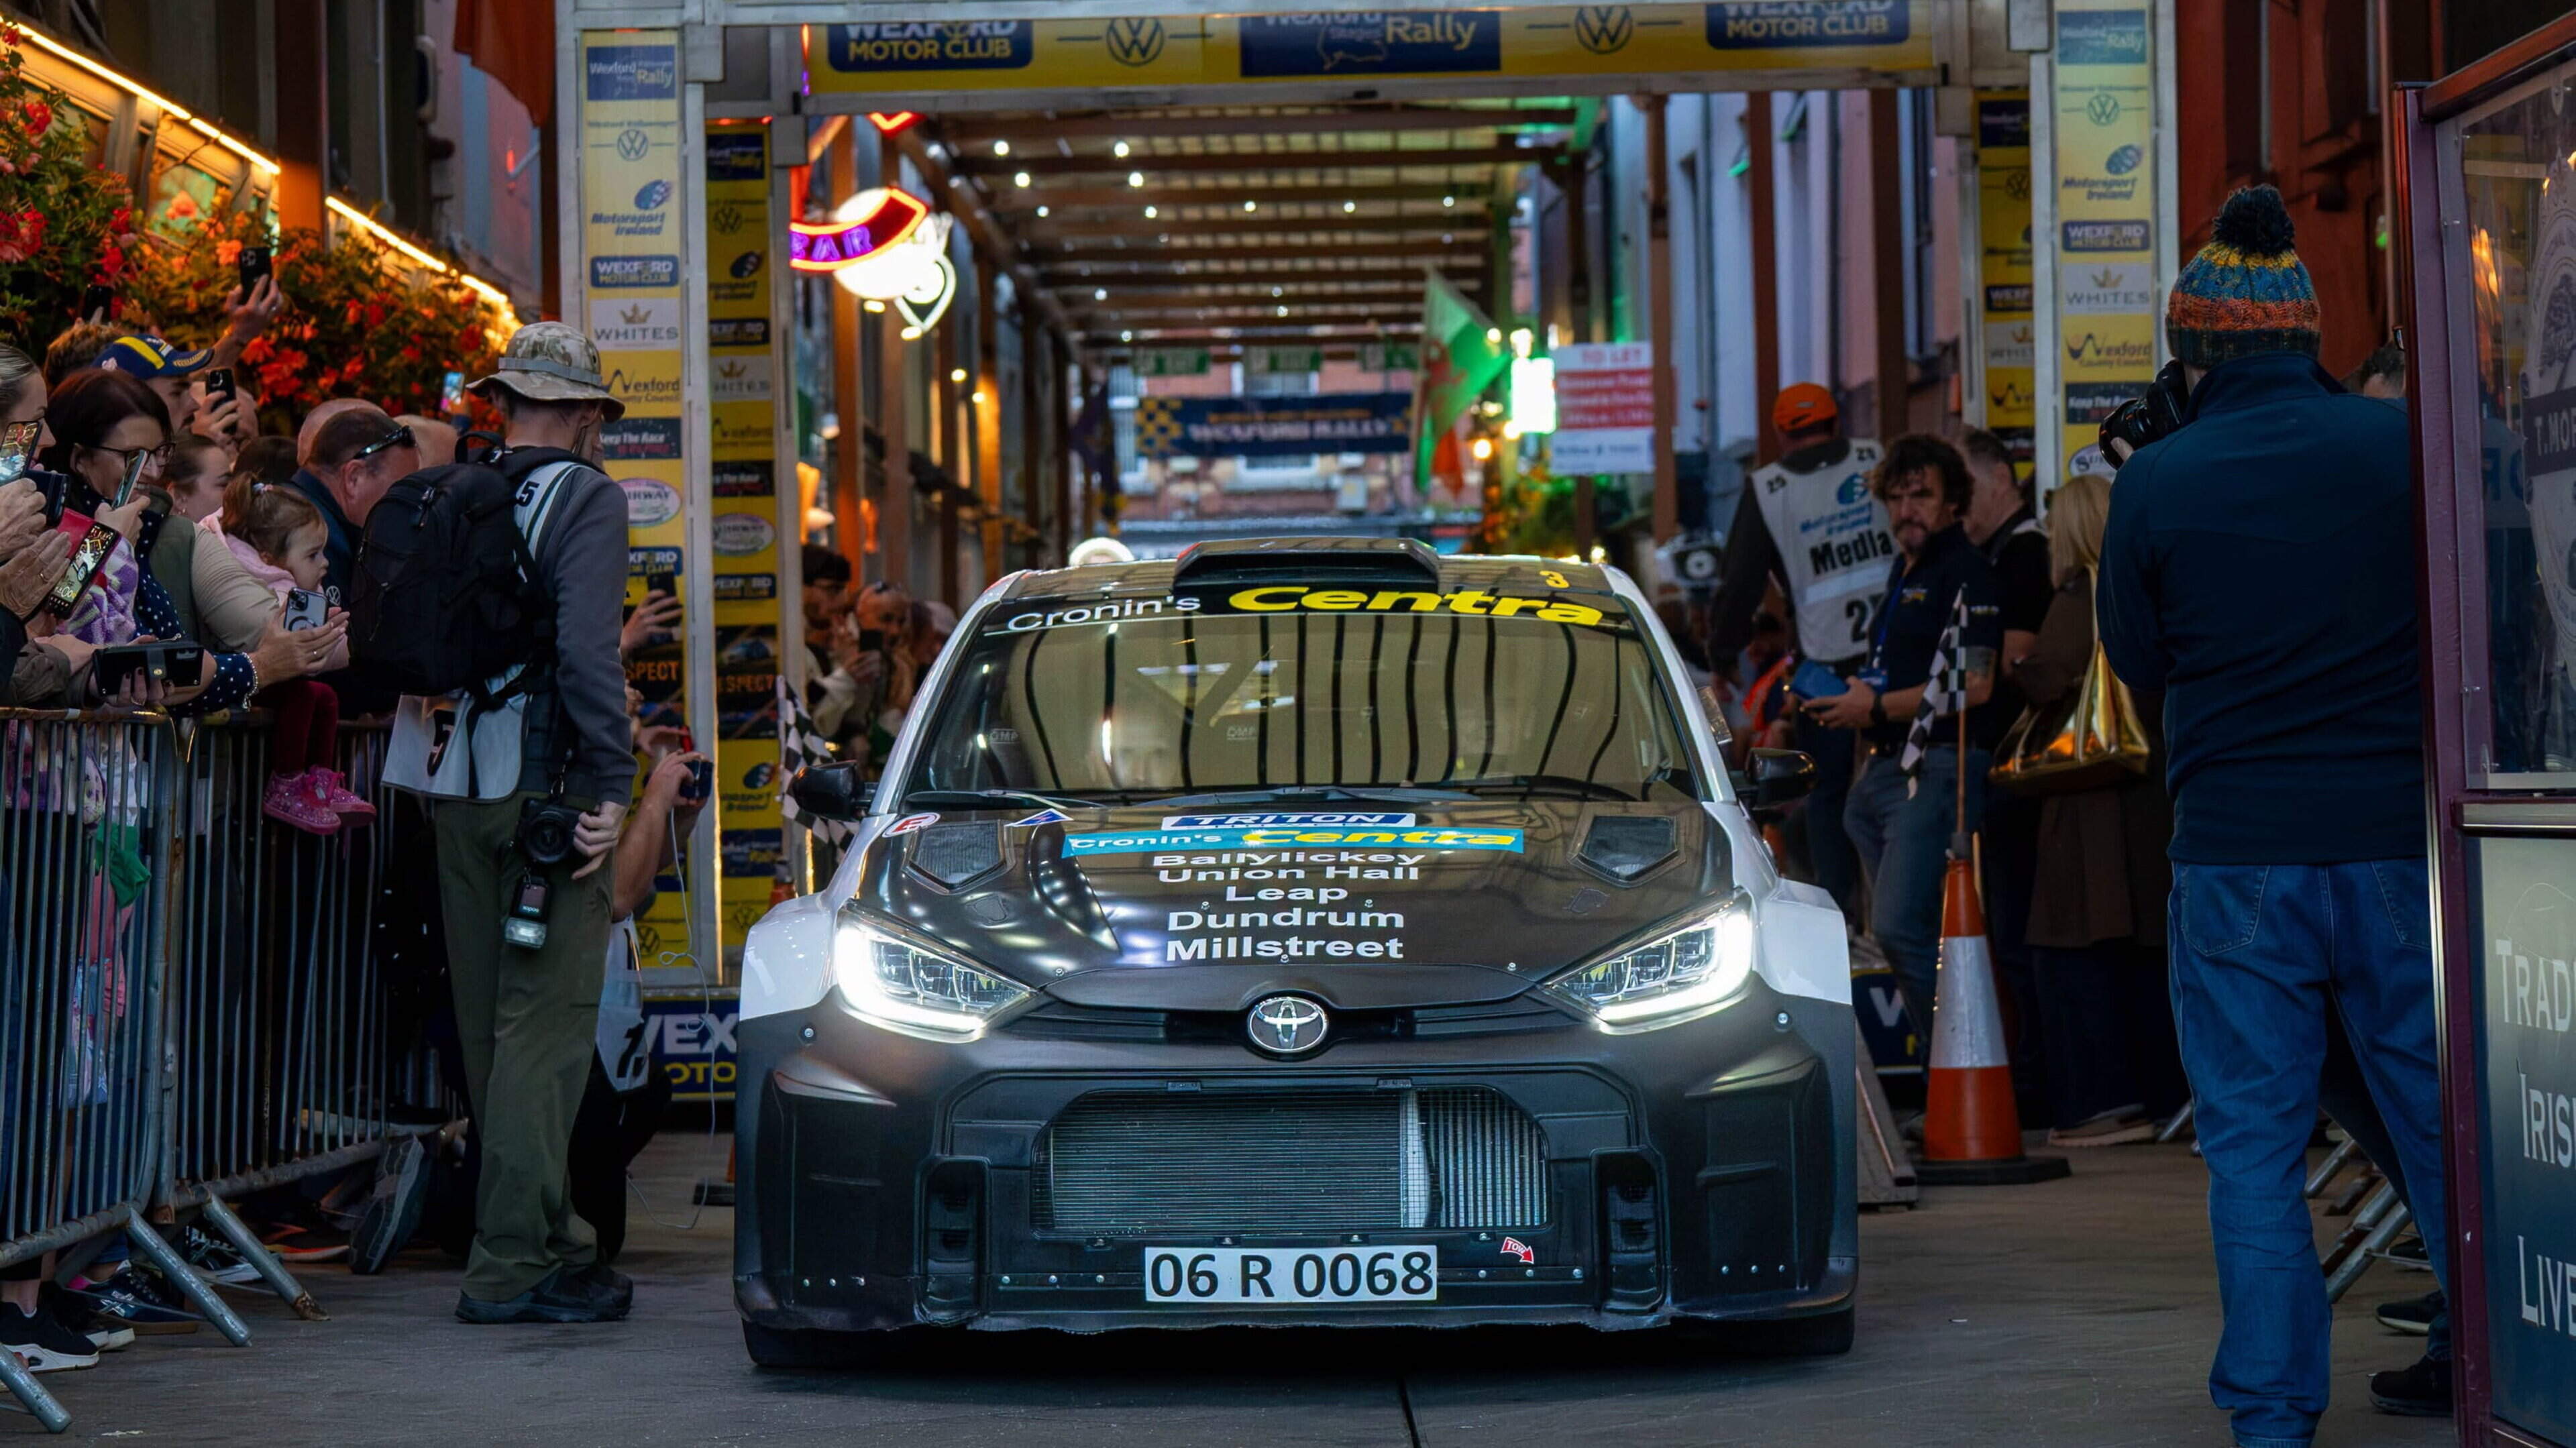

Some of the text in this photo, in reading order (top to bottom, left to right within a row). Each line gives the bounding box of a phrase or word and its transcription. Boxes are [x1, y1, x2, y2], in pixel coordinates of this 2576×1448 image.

[1387, 14, 1476, 51] Rally
[1726, 14, 1889, 38] MOTOR CLUB
[848, 38, 1012, 62] MOTOR CLUB
[637, 68, 673, 89] Rally
[2067, 291, 2149, 306] WHITES
[594, 327, 679, 341] WHITES
[2066, 333, 2152, 360] Wexford
[517, 481, 540, 507] 5
[628, 551, 678, 565] XFRD
[1809, 531, 1893, 575] Media
[1540, 570, 1570, 588] 3
[1008, 586, 1603, 631] Cronin's Centra
[626, 661, 680, 681] SPECT
[1193, 814, 1385, 826] TRITON
[1070, 830, 1516, 848] Cronin's Centra
[1152, 851, 1426, 867] Ballylickey
[1159, 865, 1419, 883] Union Hall
[1226, 885, 1348, 905] Leap
[1167, 907, 1405, 931] Dundrum
[1166, 936, 1404, 961] Millstreet
[2496, 938, 2576, 1032] TRAD
[2520, 1073, 2576, 1168] IRIS
[1507, 1239, 1526, 1254] TOW
[1150, 1251, 1434, 1298] 06 R 0068
